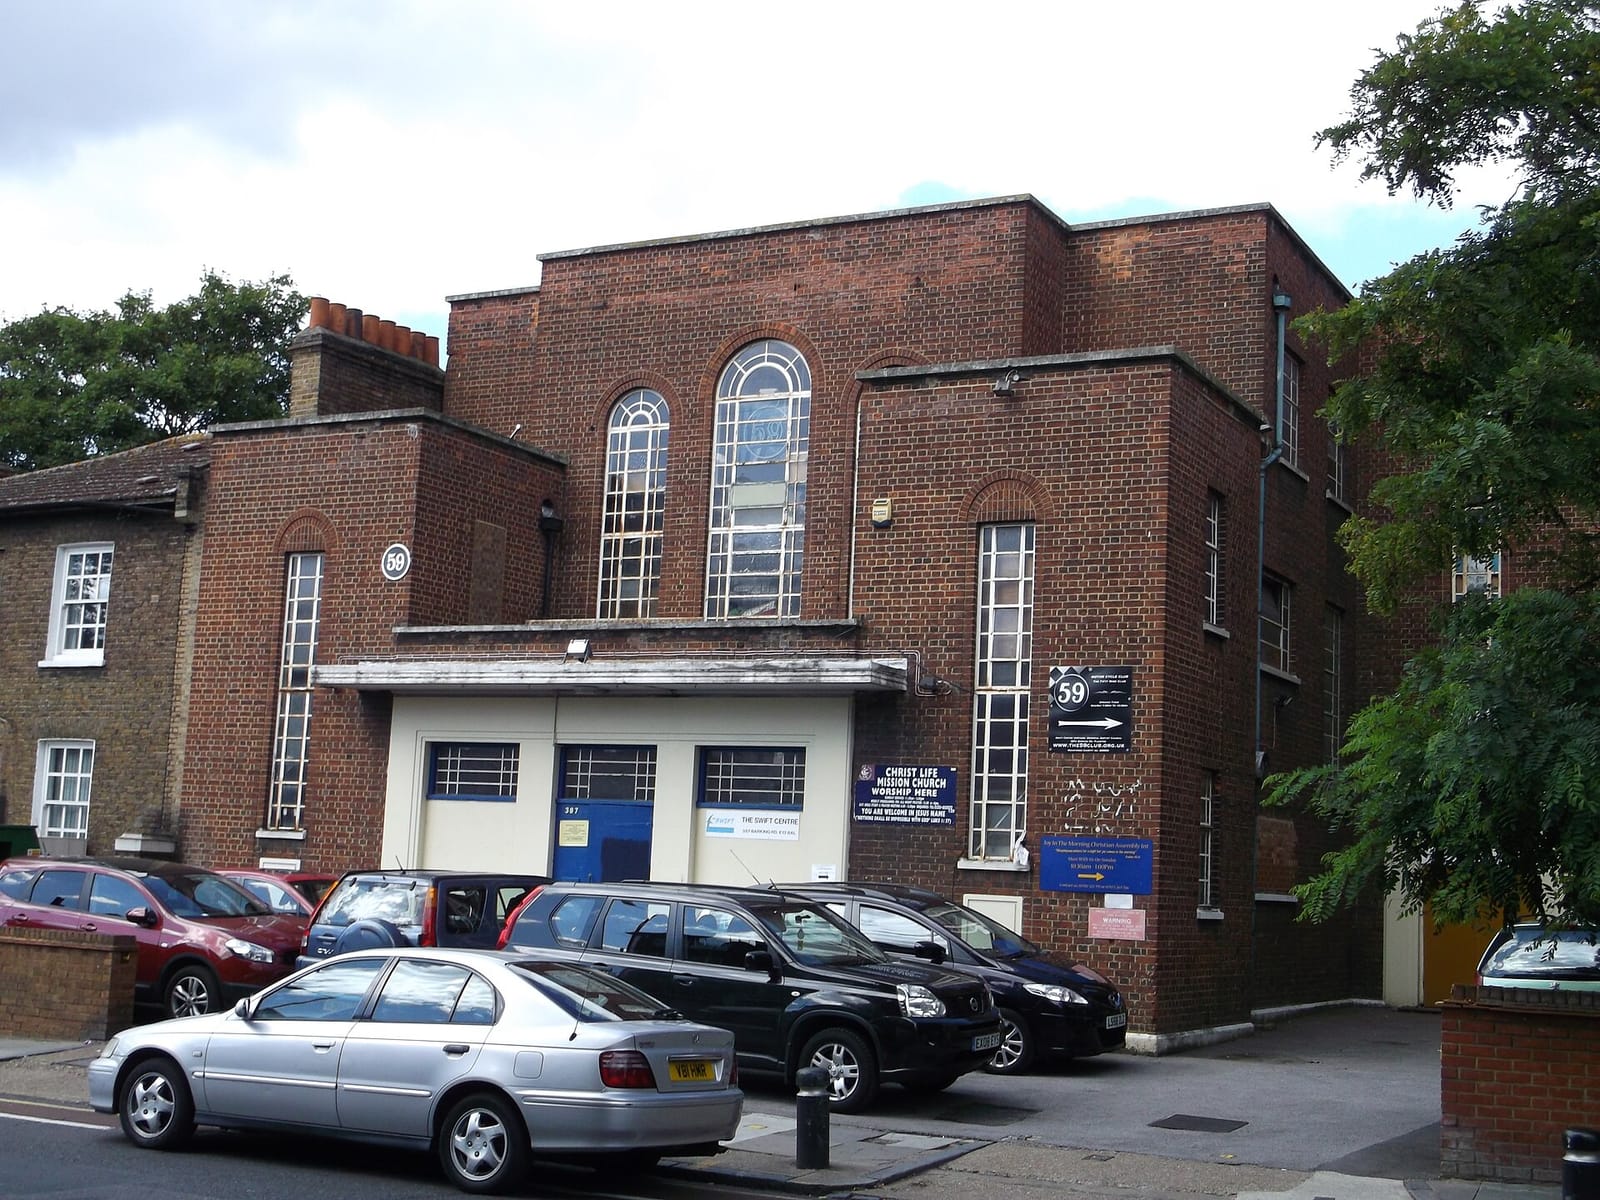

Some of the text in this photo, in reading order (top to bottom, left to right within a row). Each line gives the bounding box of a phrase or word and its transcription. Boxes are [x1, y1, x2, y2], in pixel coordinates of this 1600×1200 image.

[751, 421, 783, 441] 59
[386, 553, 405, 571] 59
[1058, 682, 1085, 704] 59
[886, 767, 917, 778] CHRIST
[920, 768, 938, 778] LIFE
[877, 778, 946, 788] MISSION CHURCH
[871, 788, 938, 797] WORSHIP HERE
[915, 809, 929, 817] JESUS
